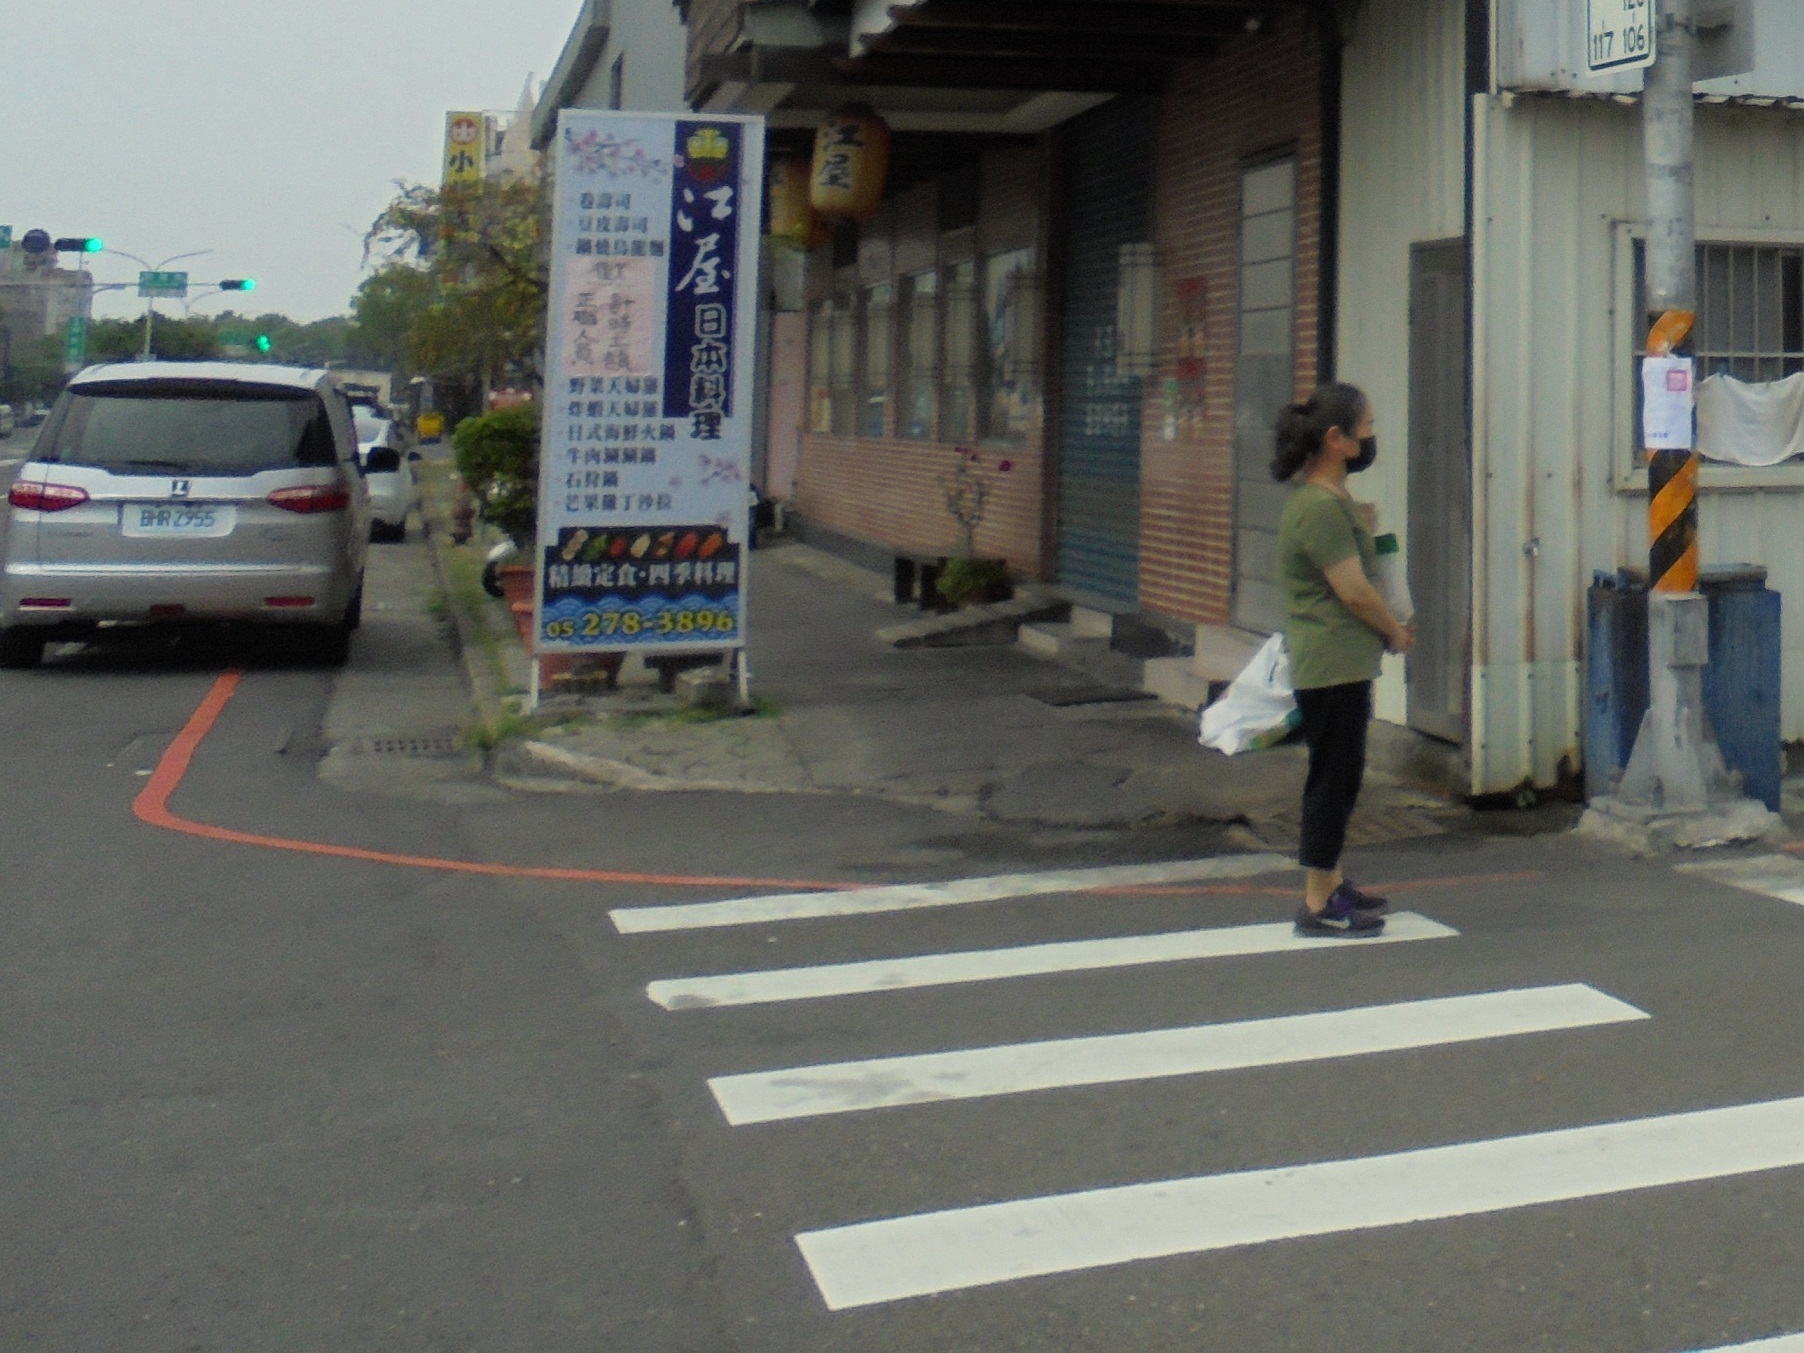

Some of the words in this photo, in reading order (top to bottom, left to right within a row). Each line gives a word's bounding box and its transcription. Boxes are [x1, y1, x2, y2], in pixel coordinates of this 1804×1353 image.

[1593, 30, 1614, 61] 117
[1623, 24, 1646, 54] 106
[675, 185, 735, 296] 江屋
[689, 303, 728, 441] 日本料理
